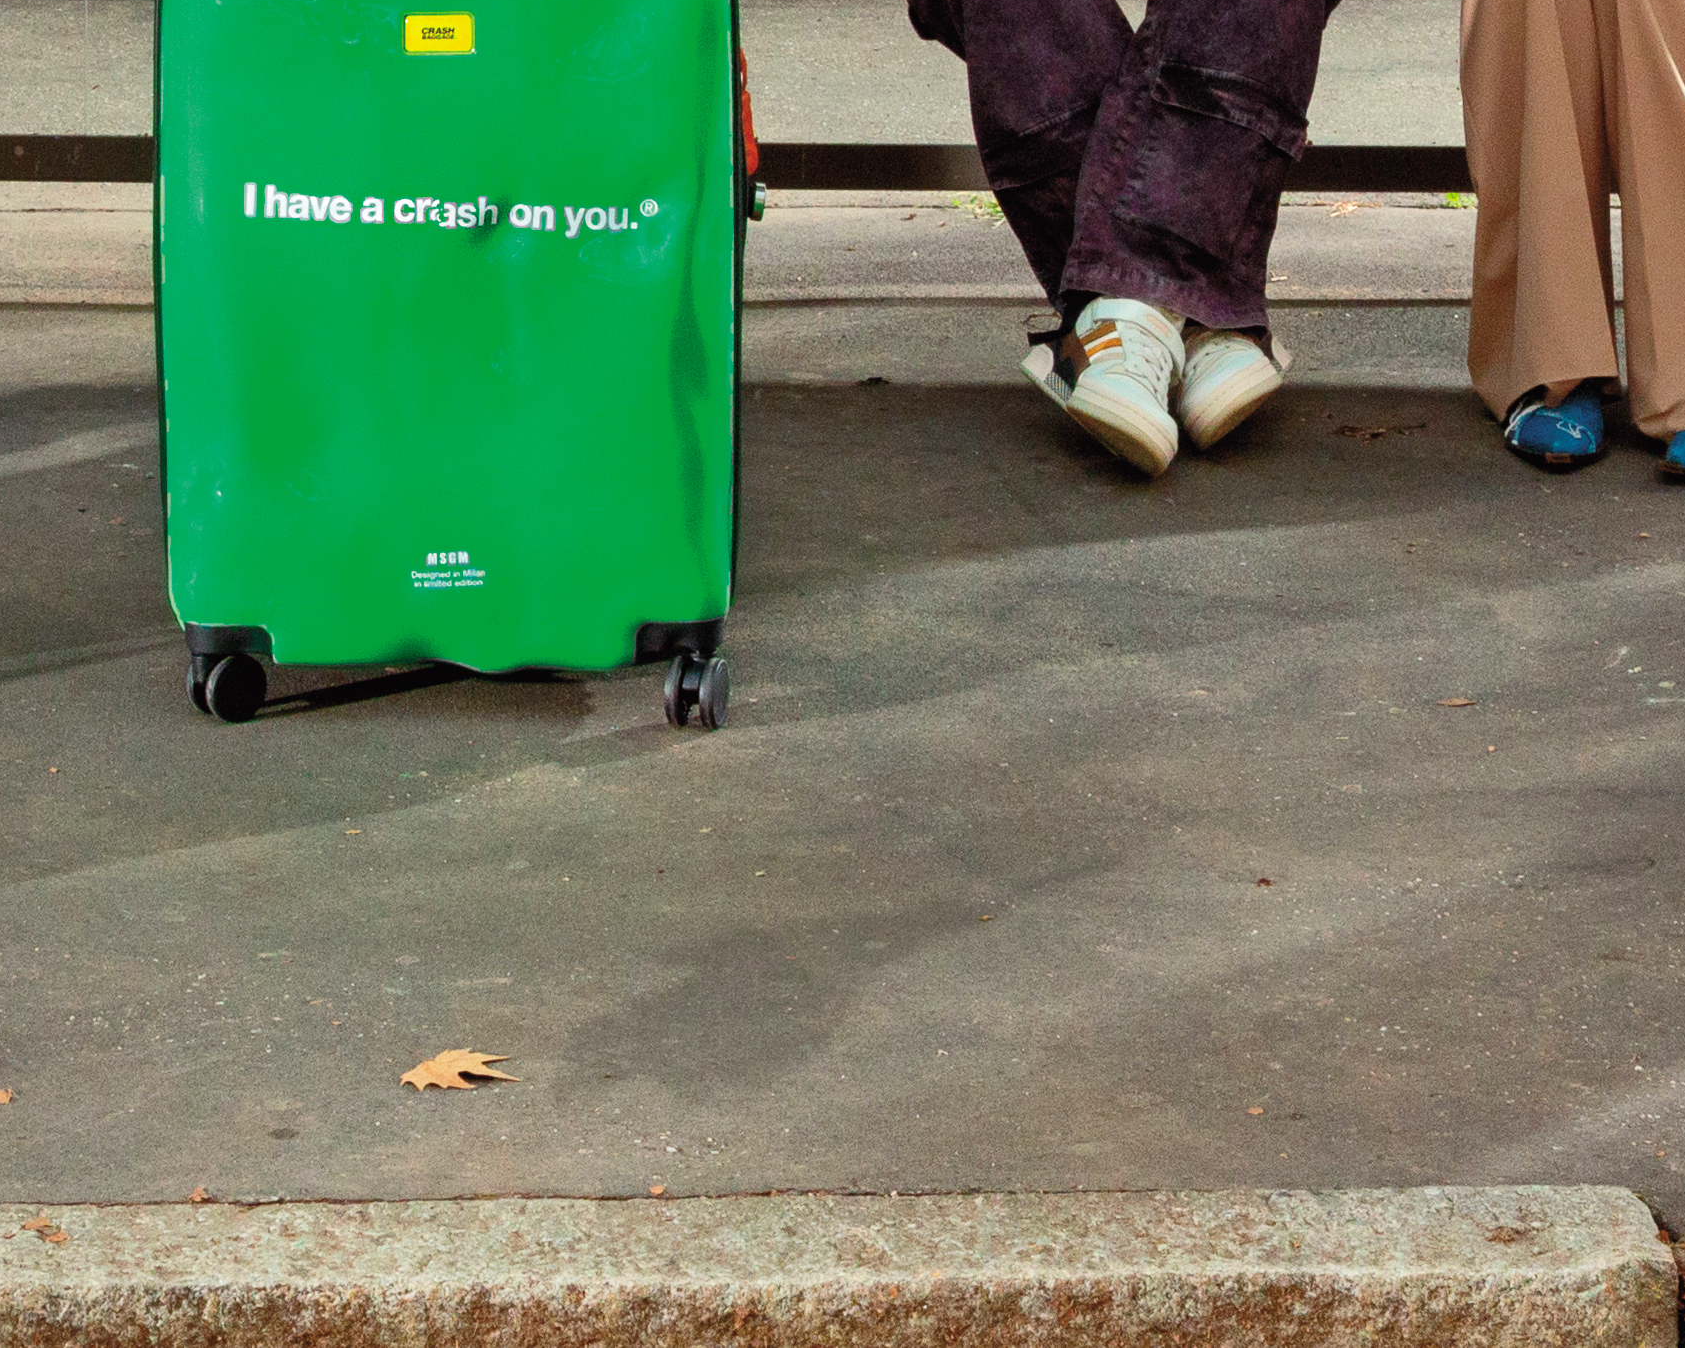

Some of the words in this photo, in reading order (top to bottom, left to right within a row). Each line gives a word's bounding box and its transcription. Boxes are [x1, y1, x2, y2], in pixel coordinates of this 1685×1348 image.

[421, 27, 455, 35] CRASH
[243, 182, 259, 219] I
[265, 184, 352, 224] have
[360, 196, 384, 224] a
[393, 195, 498, 229] crash
[508, 203, 557, 233] on
[425, 551, 470, 566] MSGM
[411, 570, 451, 580] Designed
[424, 579, 452, 588] limited
[454, 579, 483, 587] edition
